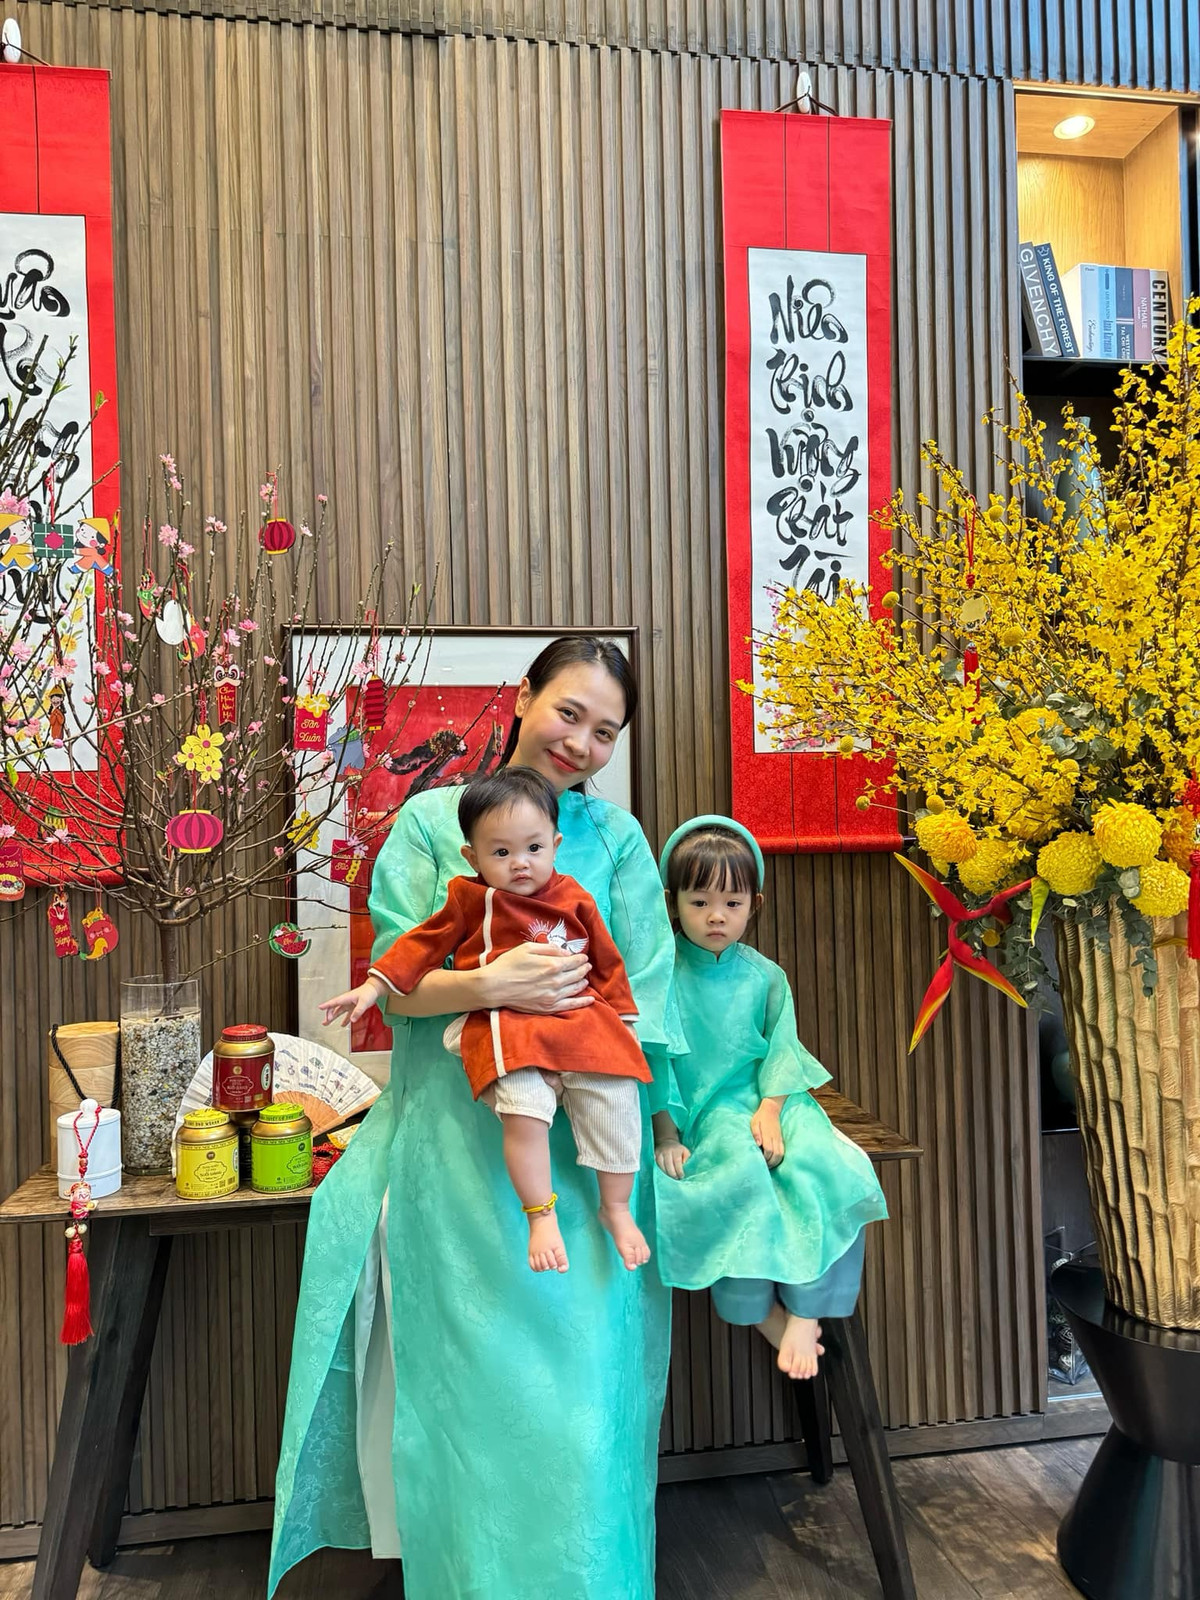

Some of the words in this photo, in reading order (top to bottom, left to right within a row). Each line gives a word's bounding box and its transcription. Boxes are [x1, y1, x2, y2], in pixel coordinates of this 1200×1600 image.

[1042, 257, 1055, 282] KING
[1020, 248, 1059, 354] GIVENCHY
[1049, 283, 1060, 296] OF
[769, 274, 849, 344] Niên
[1053, 296, 1065, 317] THE
[1140, 296, 1148, 329] NATHALIE
[1152, 280, 1168, 358] CENTURY
[1058, 317, 1075, 354] FOREST
[299, 732, 322, 743] Xuân
[301, 719, 320, 729] Tân
